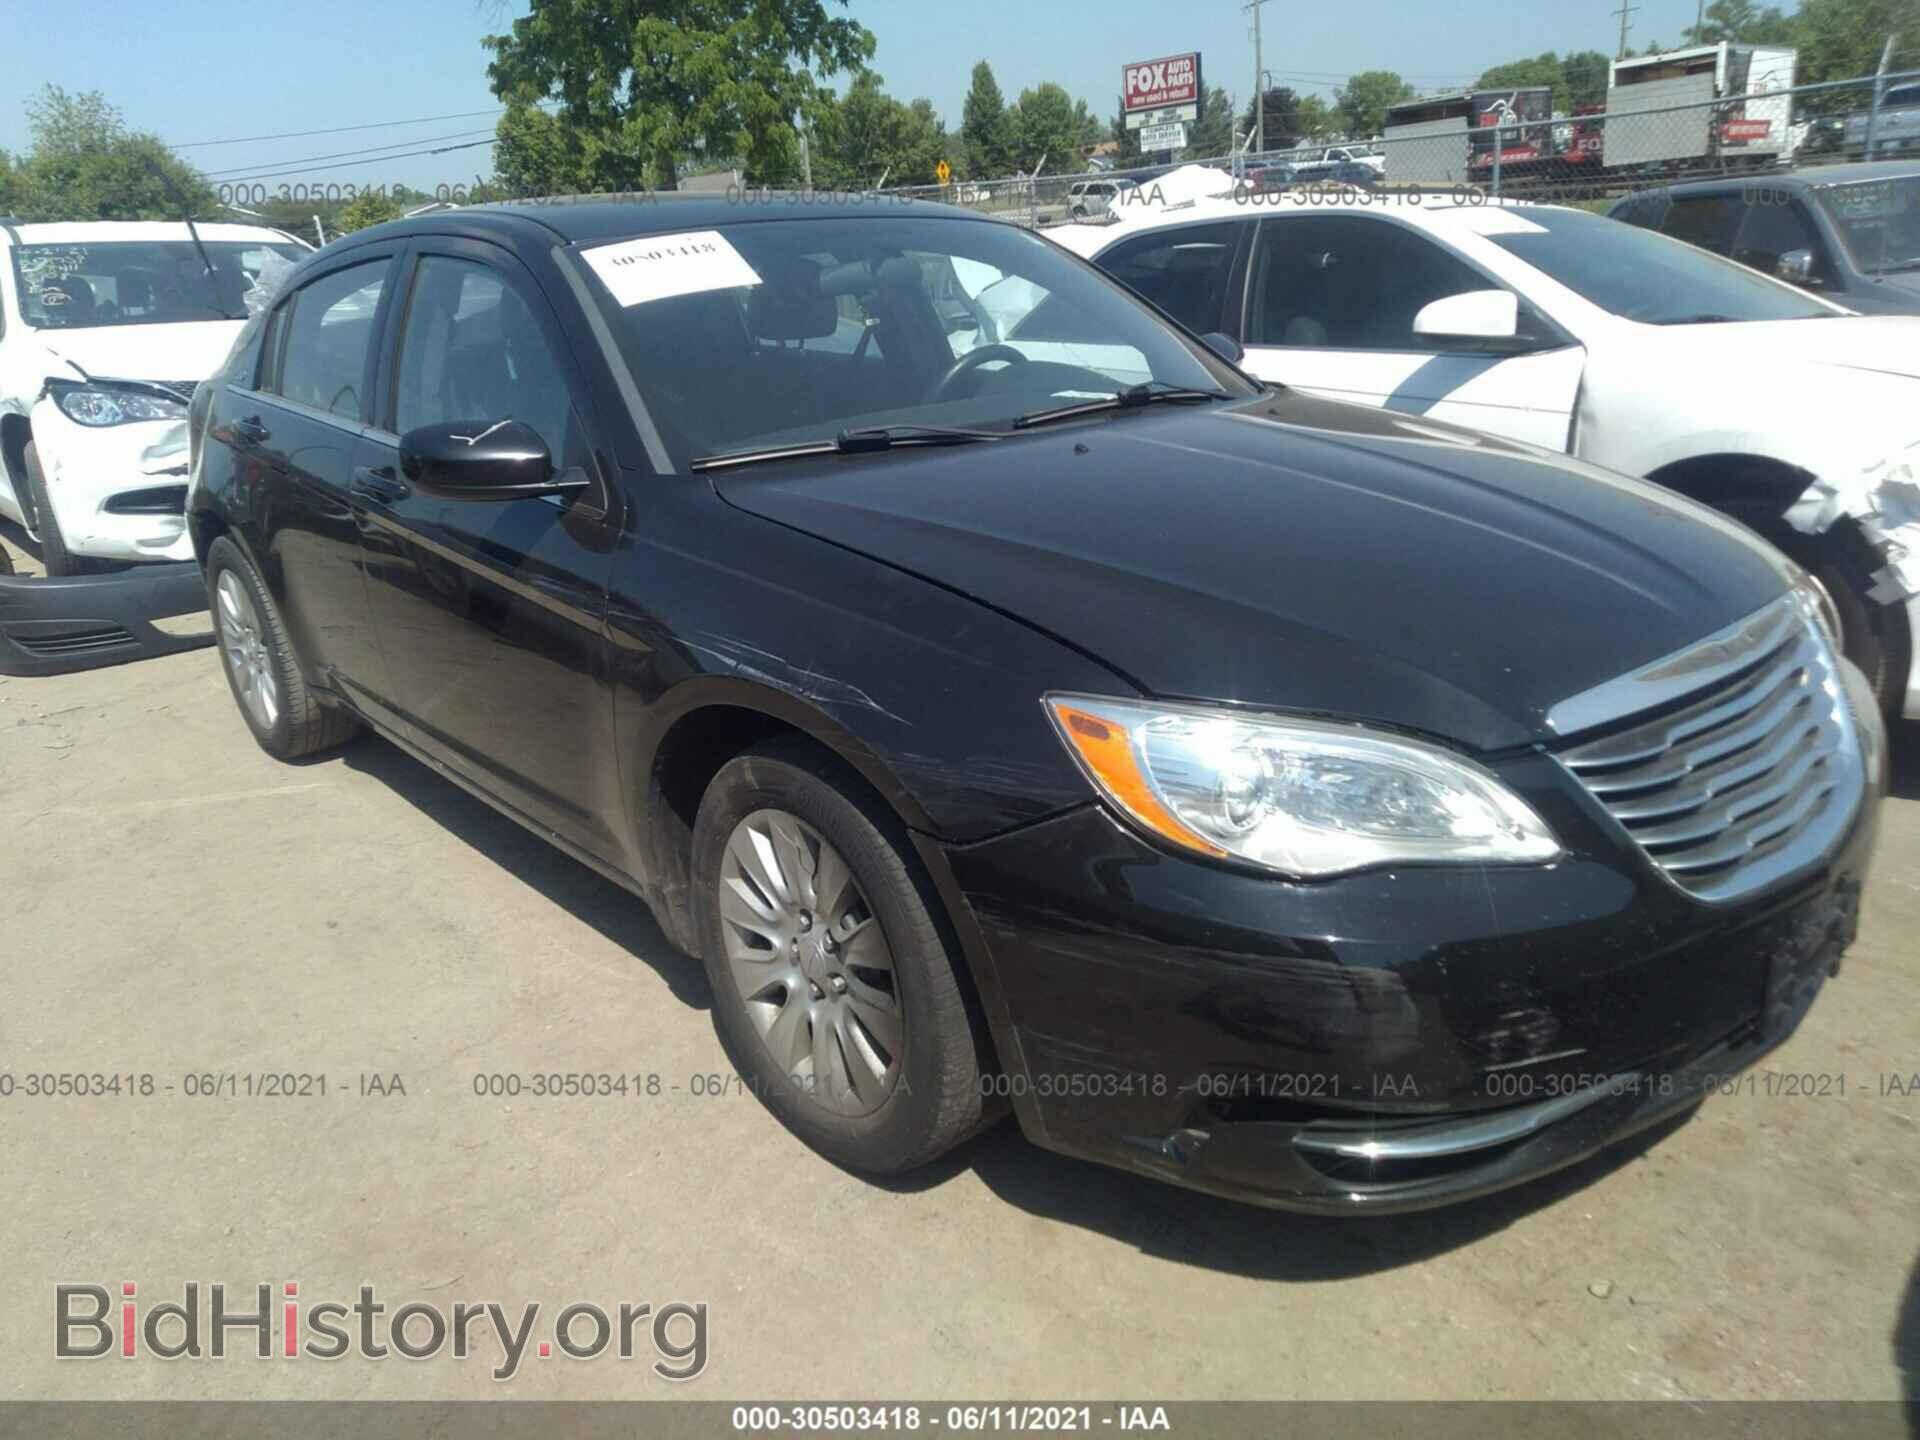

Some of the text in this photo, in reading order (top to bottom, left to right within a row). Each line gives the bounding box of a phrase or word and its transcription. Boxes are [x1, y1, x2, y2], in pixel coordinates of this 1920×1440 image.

[1127, 60, 1190, 95] FOX AUTO
[1167, 71, 1193, 87] PARTS
